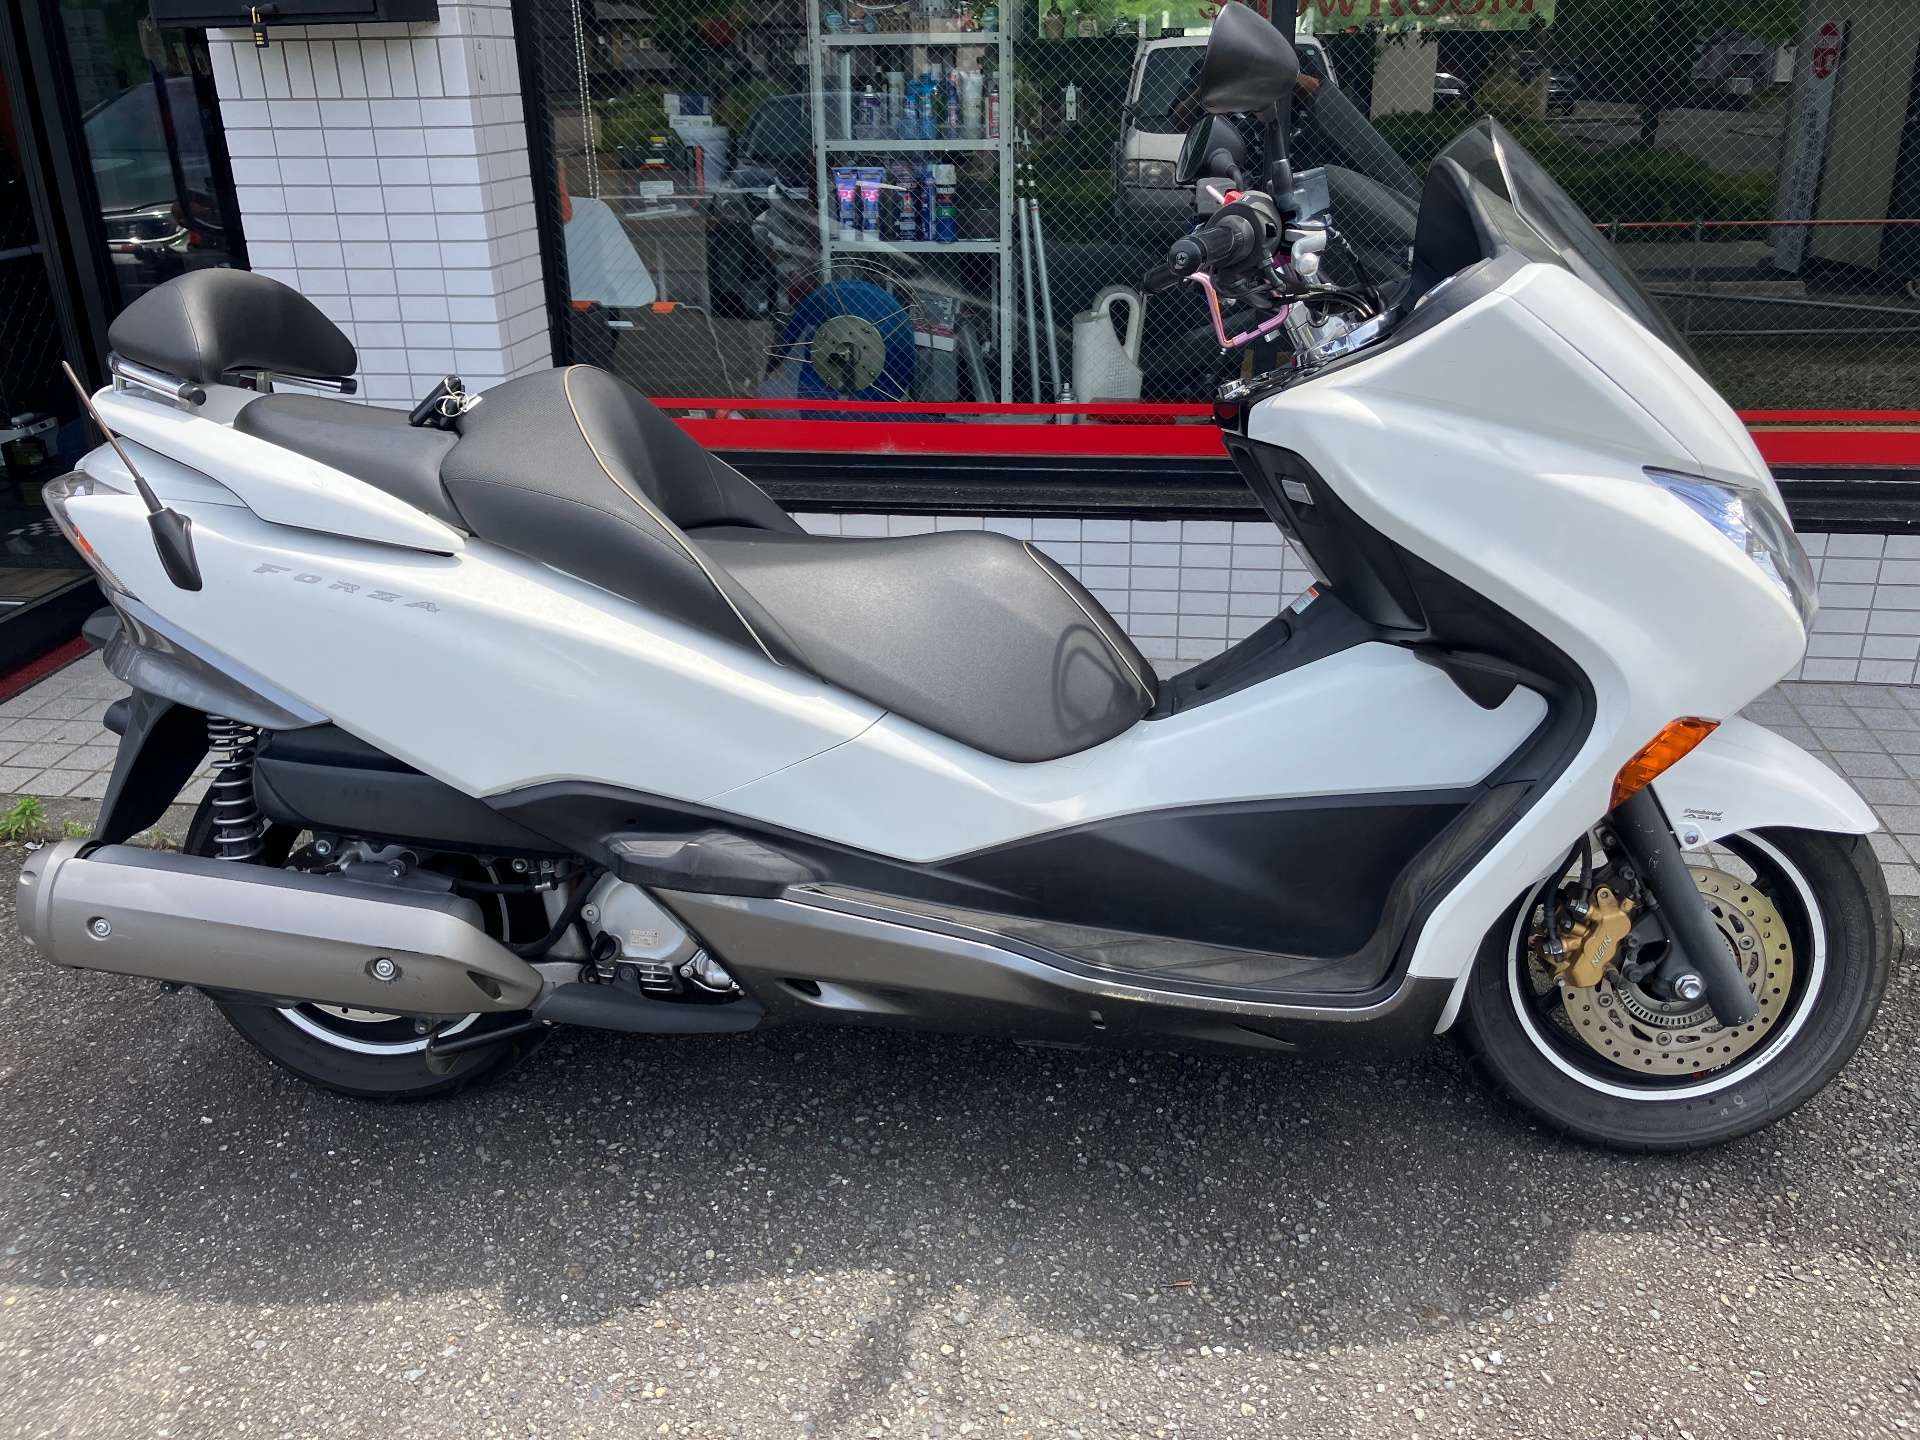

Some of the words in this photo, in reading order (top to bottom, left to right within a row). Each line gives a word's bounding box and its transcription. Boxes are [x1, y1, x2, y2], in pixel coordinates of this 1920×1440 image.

[1199, 0, 1535, 19] WROOM
[252, 562, 441, 613] FORZA
[1682, 813, 1723, 821] ABS
[1683, 808, 1724, 817] Combined
[1590, 933, 1613, 968] NISSIN
[1804, 897, 1862, 1066] BRIDGESTONE
